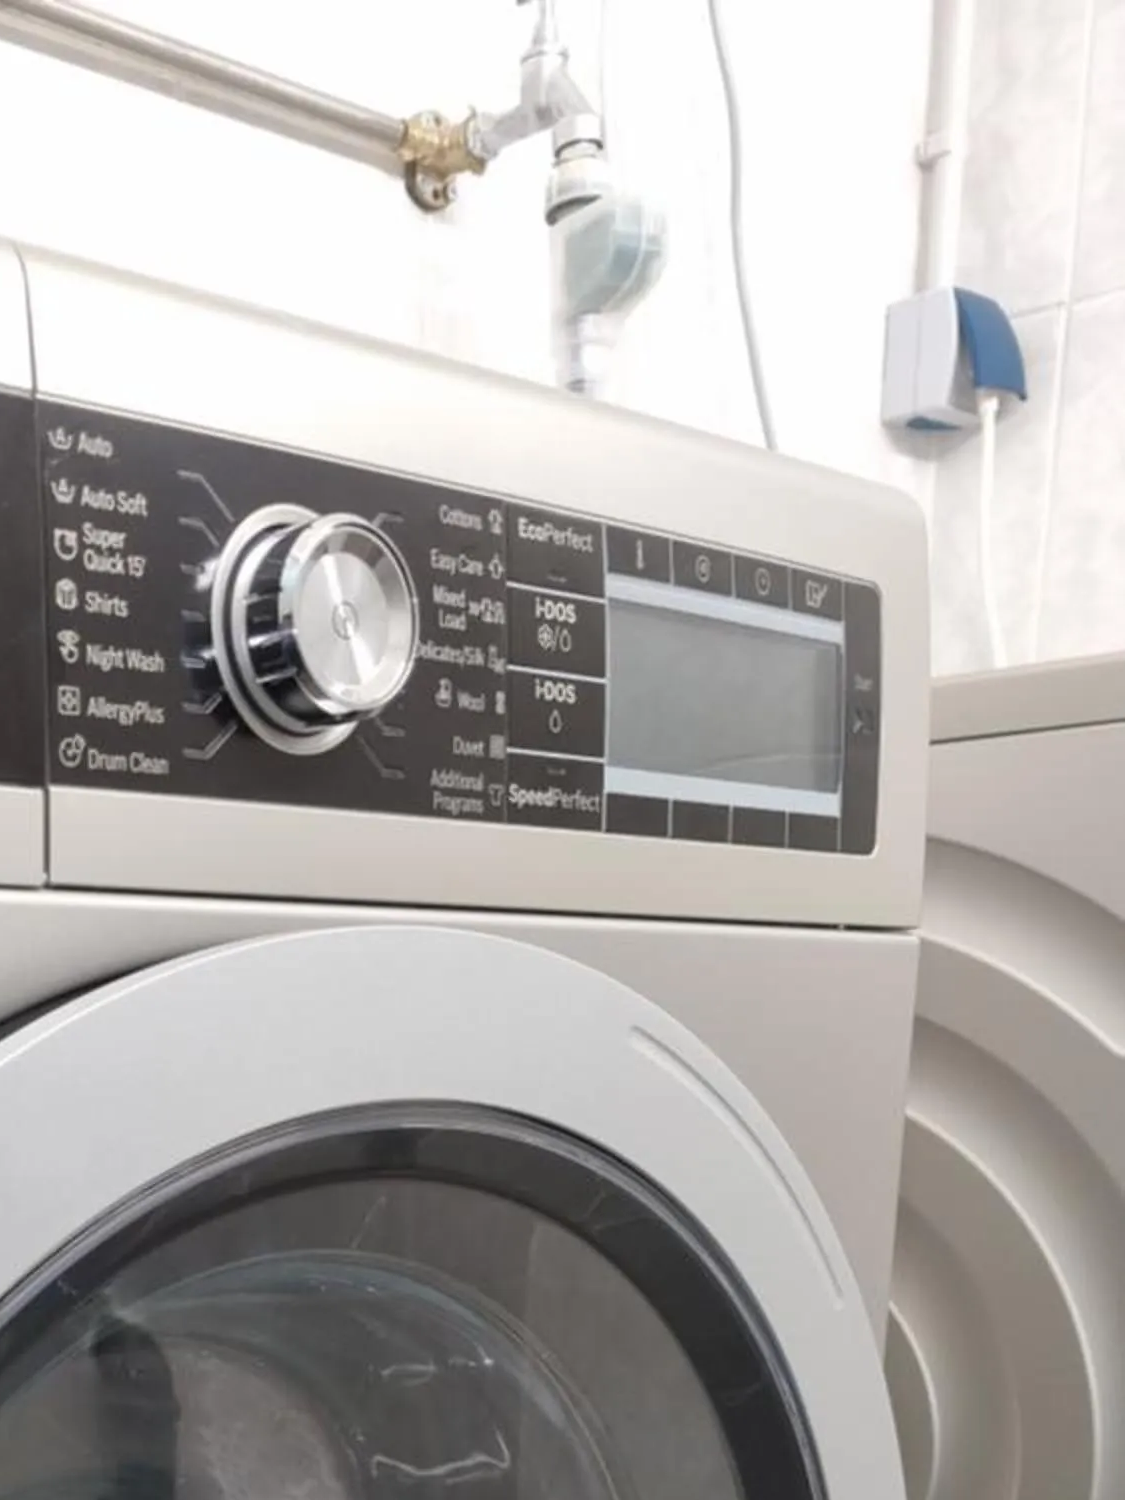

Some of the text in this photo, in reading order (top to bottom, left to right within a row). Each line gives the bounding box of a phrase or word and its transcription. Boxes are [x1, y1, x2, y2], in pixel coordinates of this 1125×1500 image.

[77, 432, 113, 458] Auto
[80, 485, 148, 516] Auto Soft
[82, 523, 127, 550] Super
[517, 516, 594, 553] EcoPerfect
[83, 551, 125, 576] Quick
[430, 548, 484, 578] Easy Care
[84, 593, 129, 618] Shirts
[535, 596, 577, 624] i-DOS
[86, 645, 165, 672] Night Wash
[535, 679, 577, 704] i-DOS
[86, 696, 165, 726] AllergyPlus
[87, 748, 169, 775] Drum Clean
[508, 782, 601, 814] SpeedPerfect
